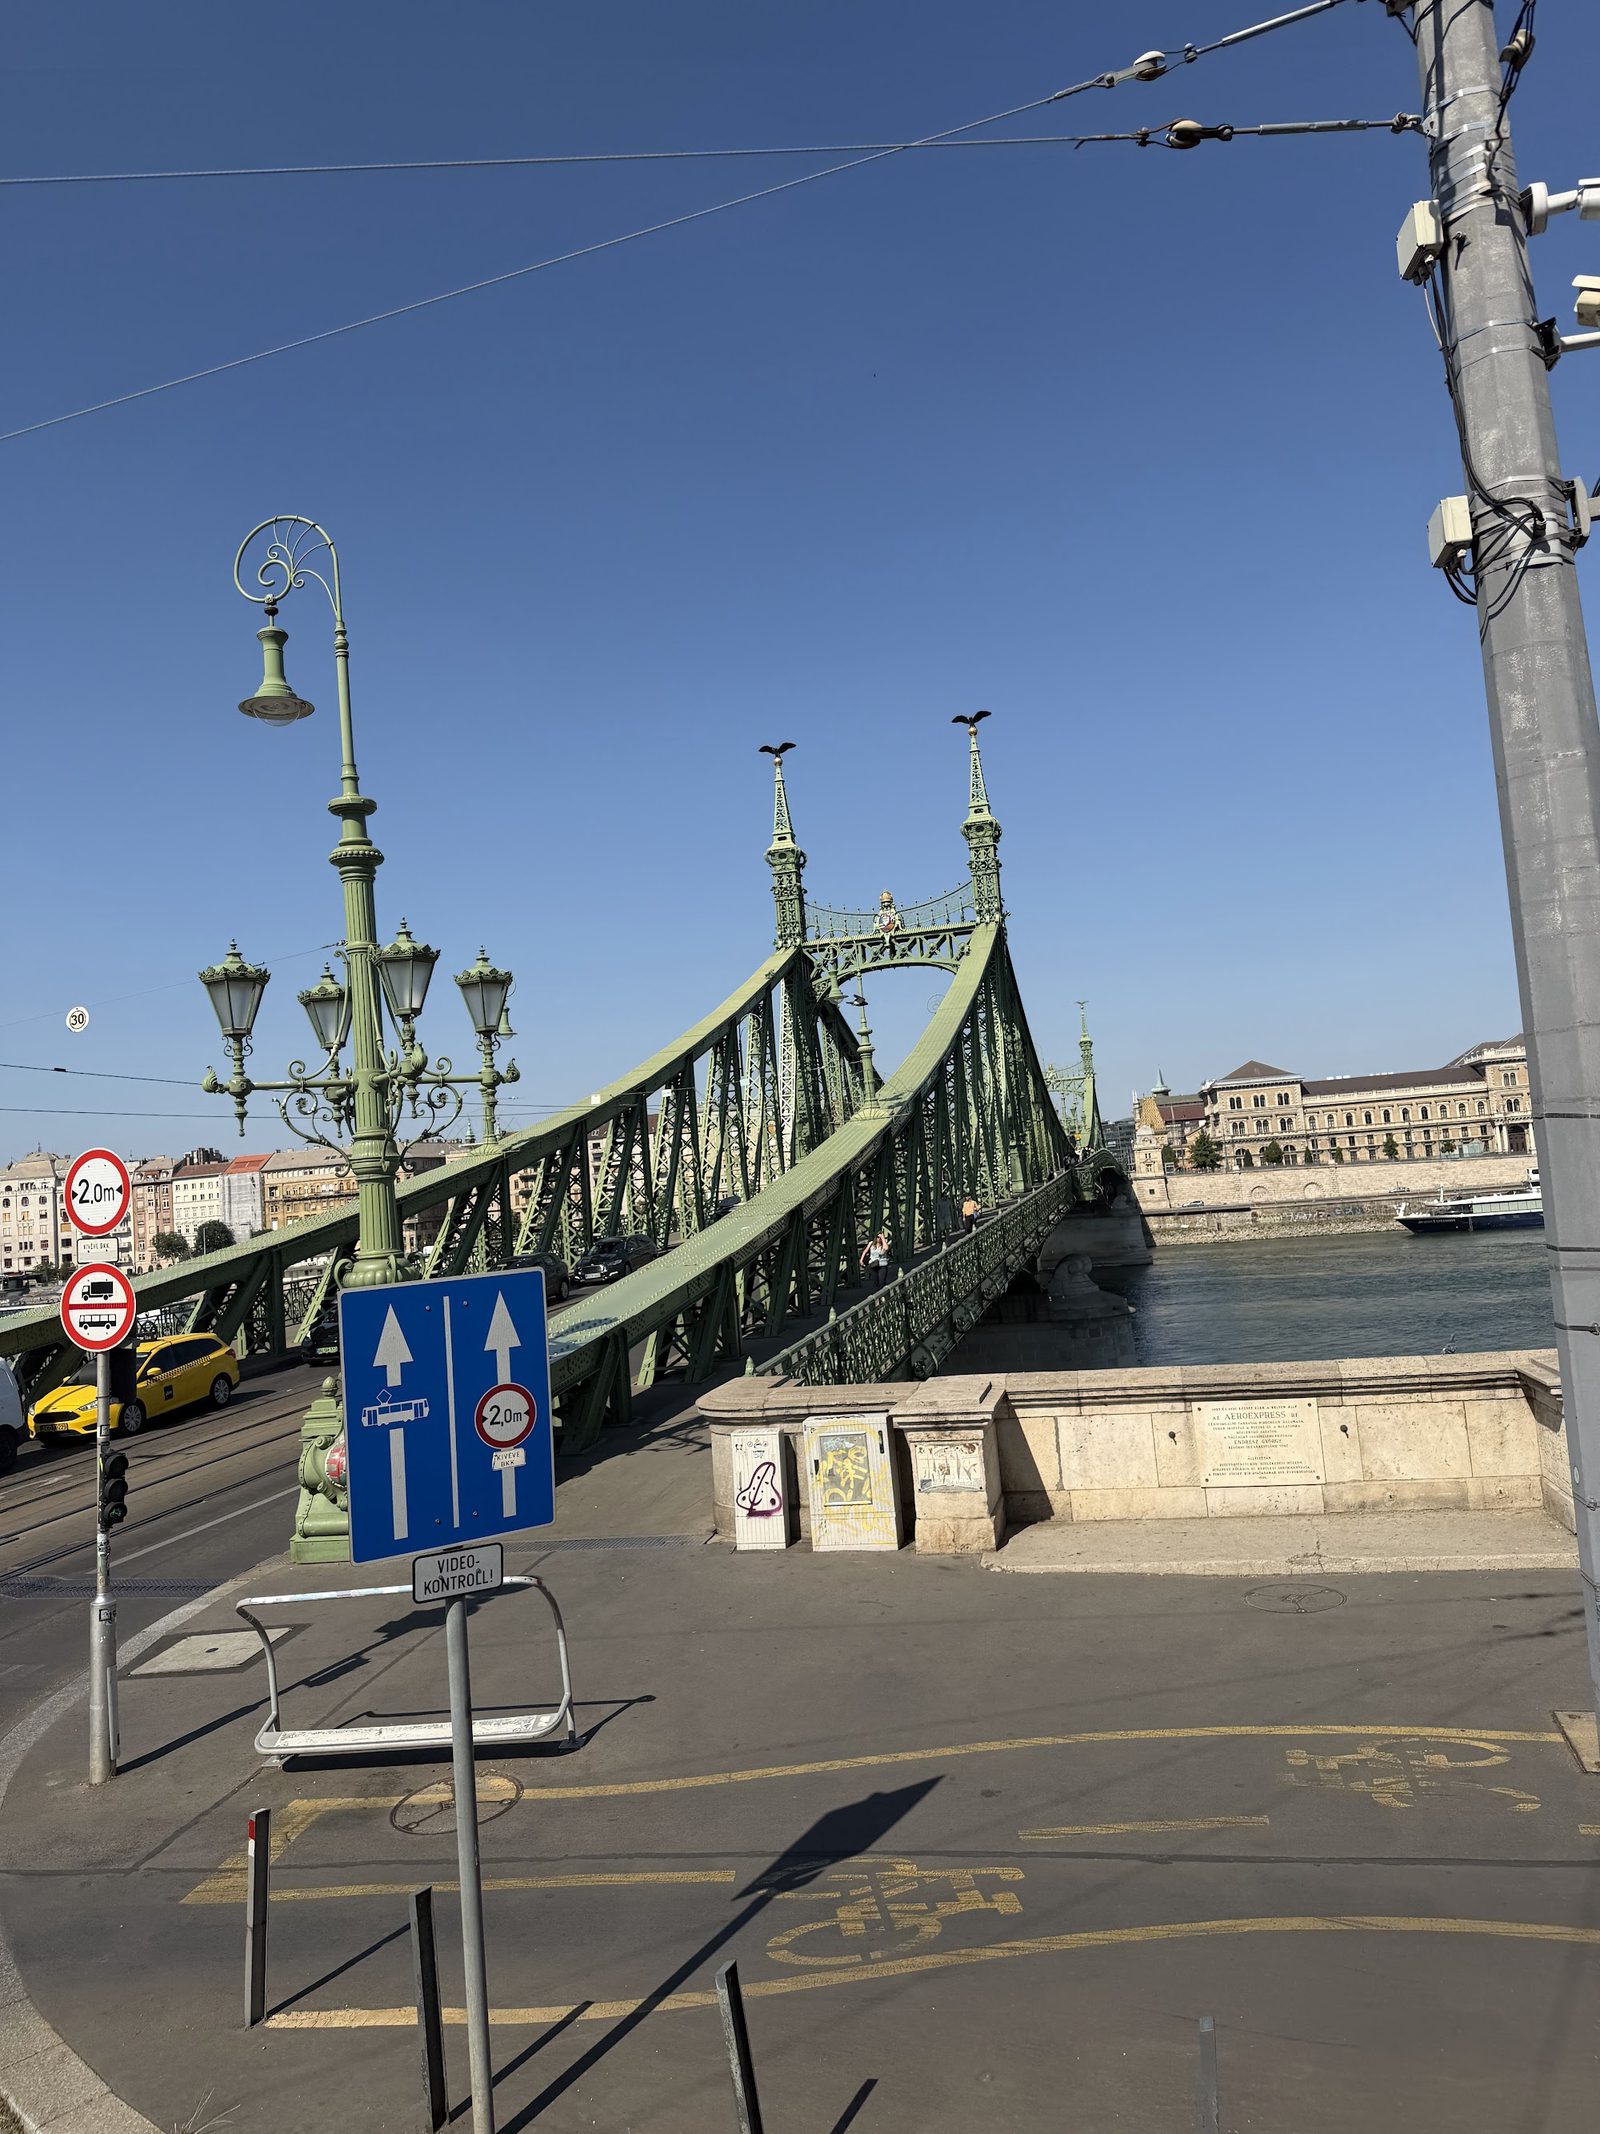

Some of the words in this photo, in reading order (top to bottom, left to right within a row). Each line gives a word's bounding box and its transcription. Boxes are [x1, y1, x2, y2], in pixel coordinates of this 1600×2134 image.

[71, 1013, 84, 1025] 30
[1224, 1410, 1287, 1420] AEROEXPRESS
[437, 1554, 480, 1574] VIDEO-
[424, 1569, 493, 1595] KONTROLL!
